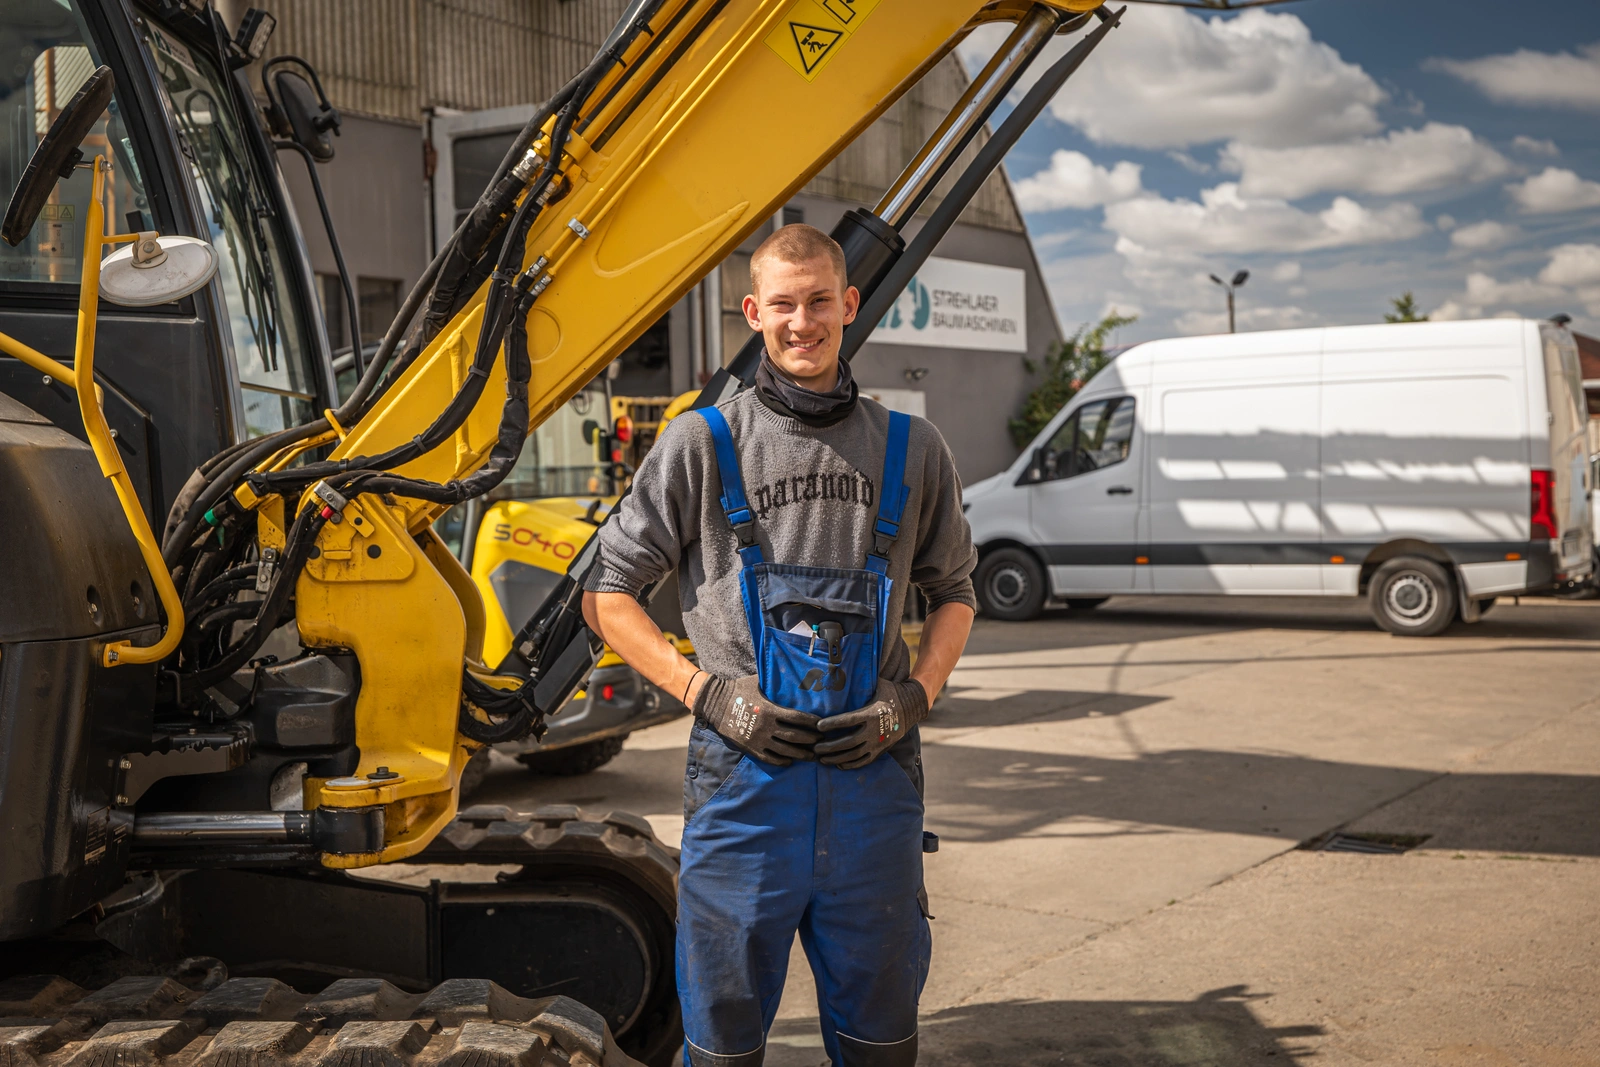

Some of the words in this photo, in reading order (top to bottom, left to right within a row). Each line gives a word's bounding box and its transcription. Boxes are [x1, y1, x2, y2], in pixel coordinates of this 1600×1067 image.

[932, 289, 999, 312] STREHLAER
[932, 311, 1017, 335] BAUMASCHINEN
[754, 468, 874, 520] paranoid
